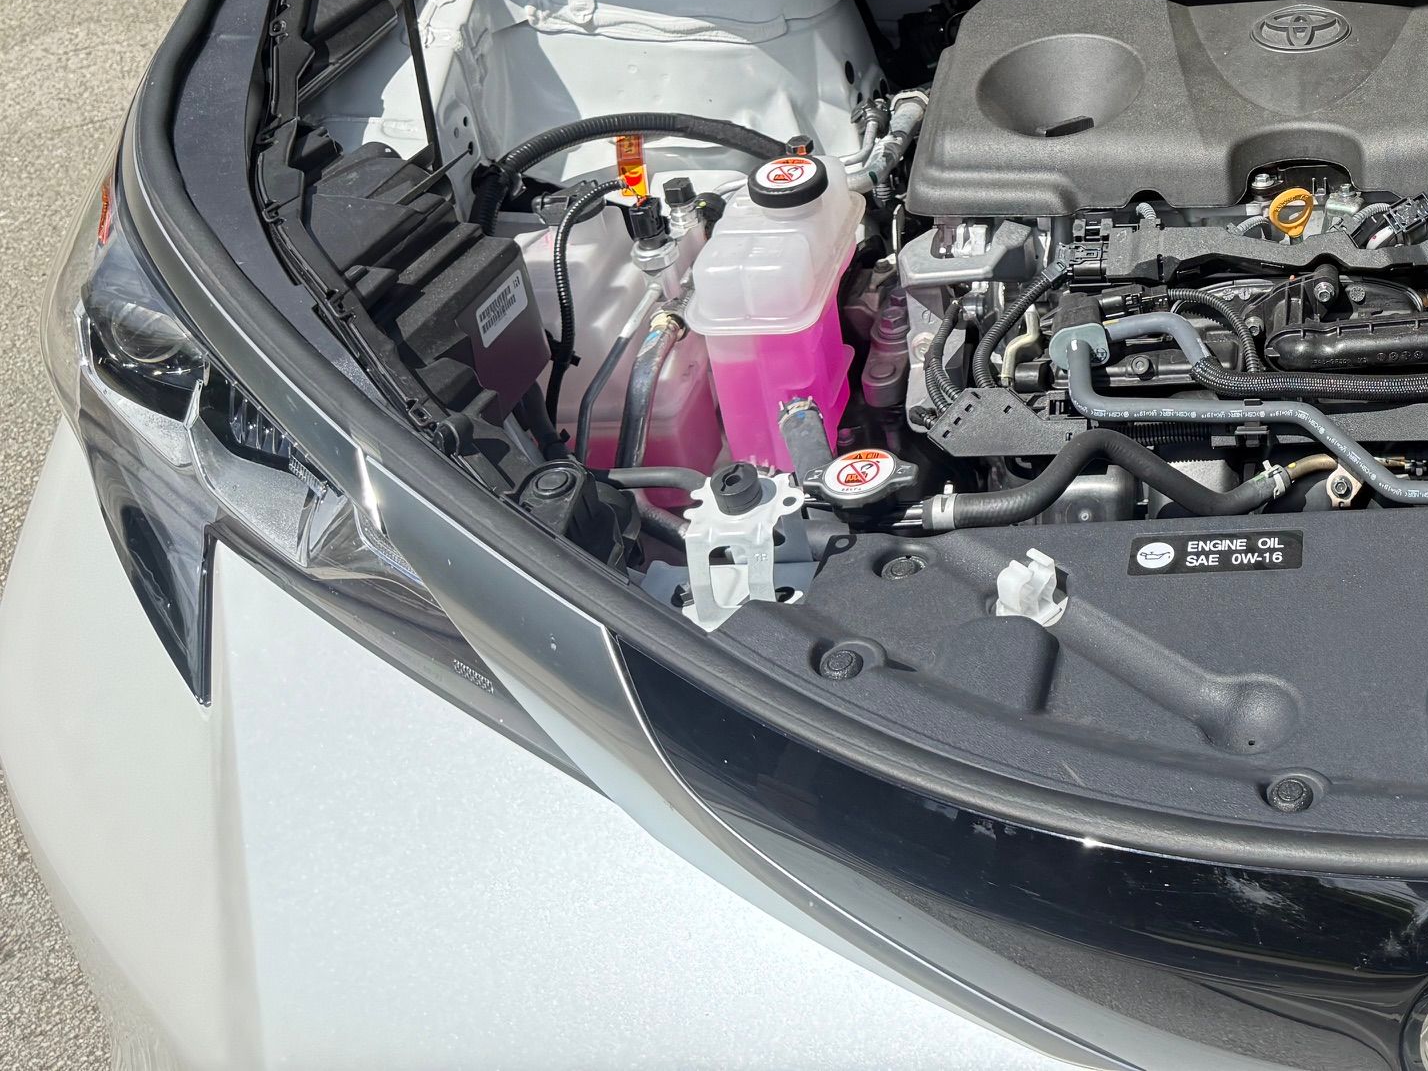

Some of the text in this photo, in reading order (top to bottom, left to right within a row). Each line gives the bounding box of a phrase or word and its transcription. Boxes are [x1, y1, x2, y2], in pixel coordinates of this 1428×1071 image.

[1187, 537, 1284, 552] ENGINE OIL
[1185, 551, 1283, 567] SAE 0W-16
